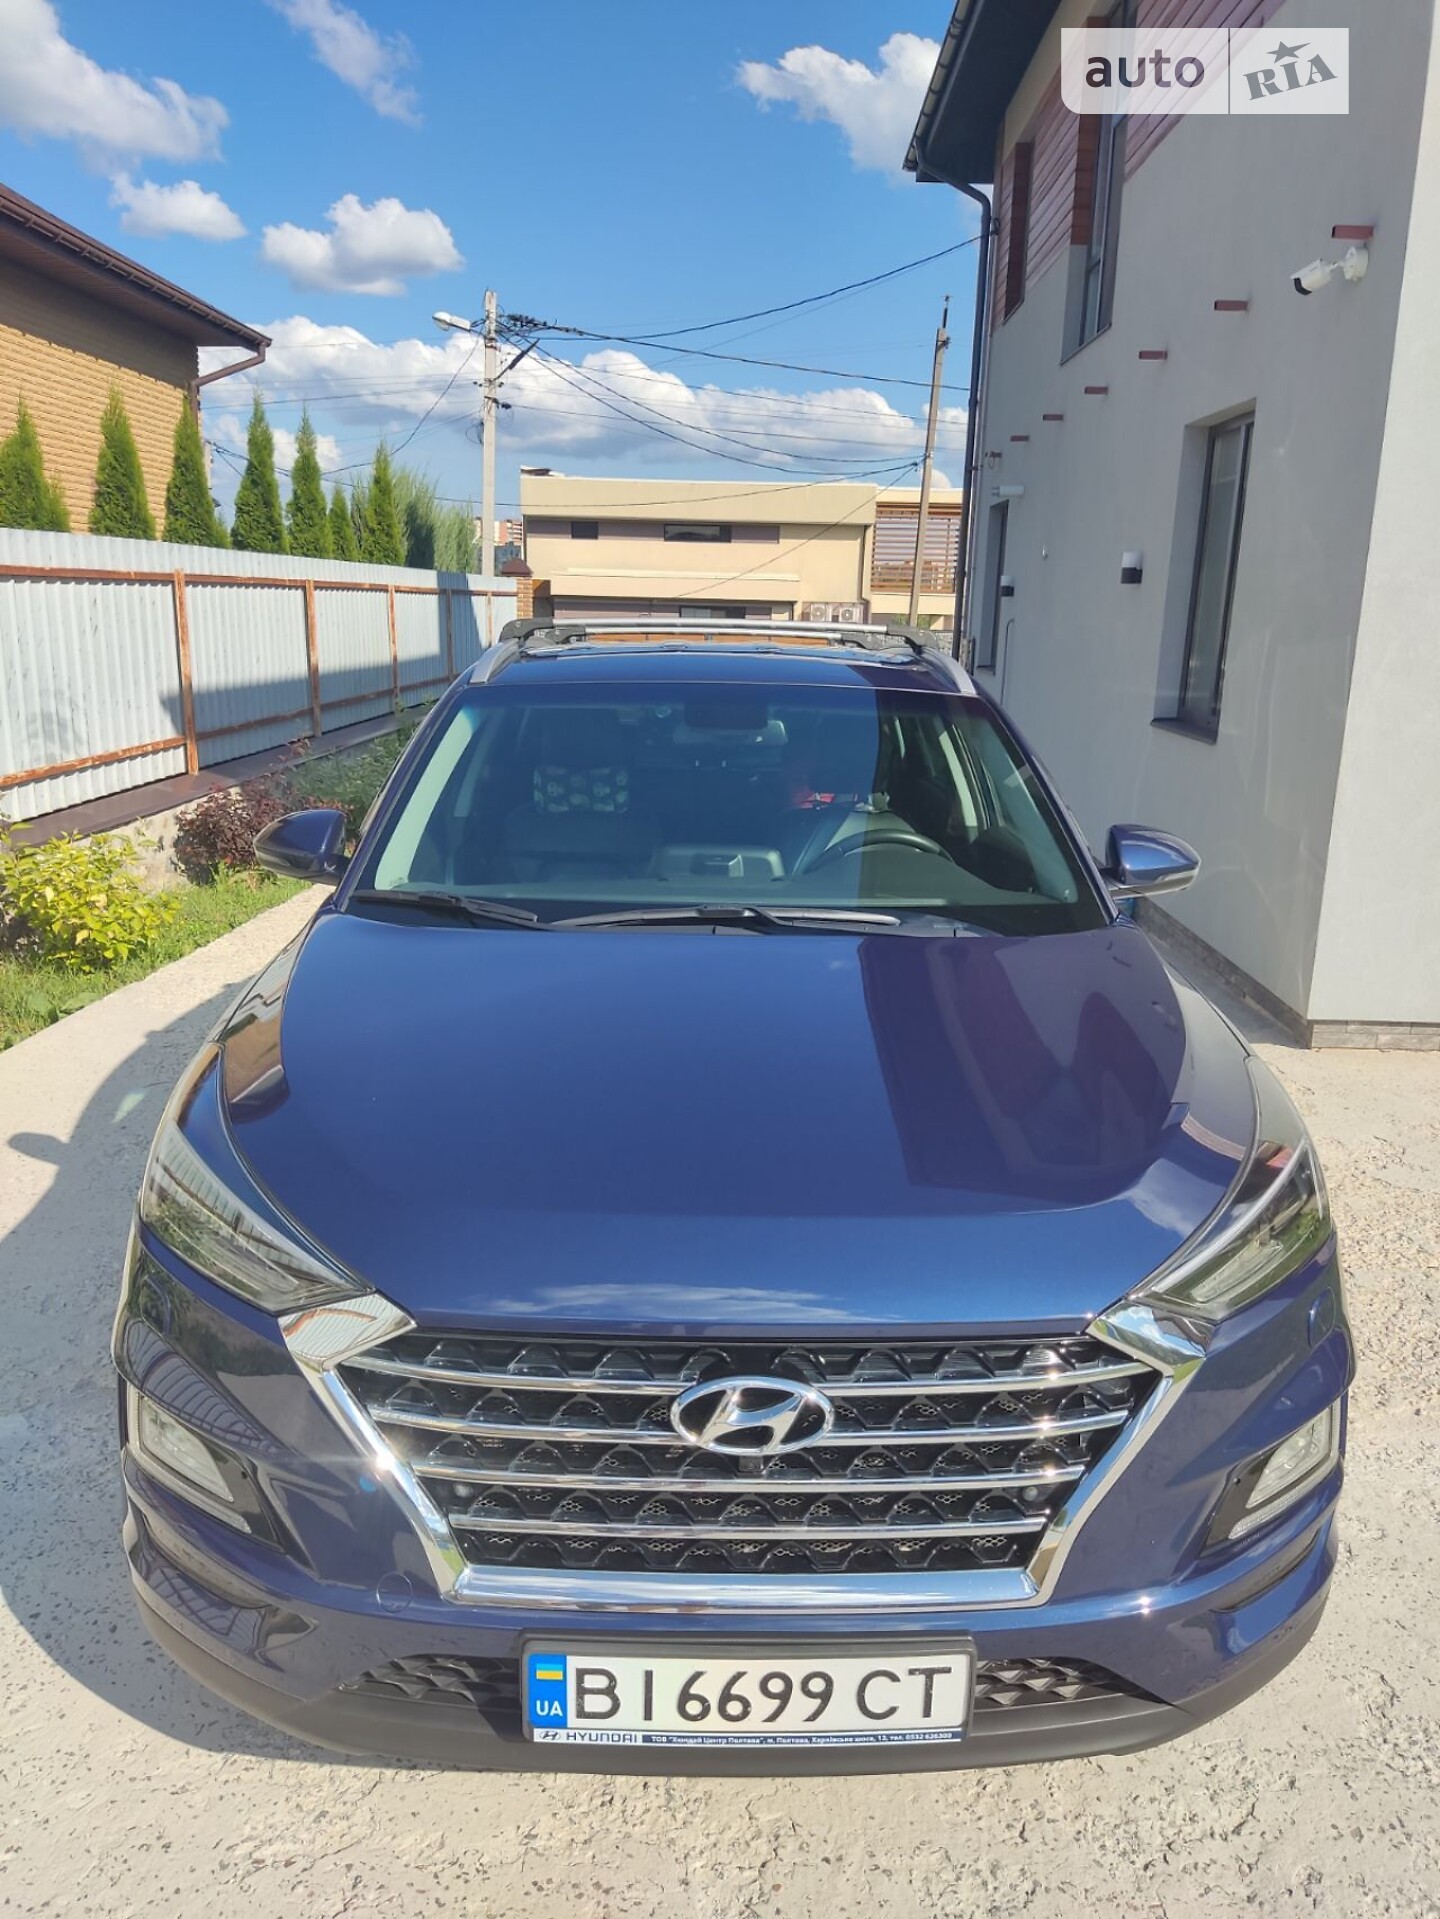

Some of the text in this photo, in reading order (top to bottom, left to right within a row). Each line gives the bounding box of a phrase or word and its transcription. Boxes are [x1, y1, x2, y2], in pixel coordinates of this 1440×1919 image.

[676, 1671, 835, 1723] 6699
[856, 1667, 953, 1720] CT
[536, 1699, 563, 1717] UA
[566, 1731, 638, 1743] HYUNDAI
